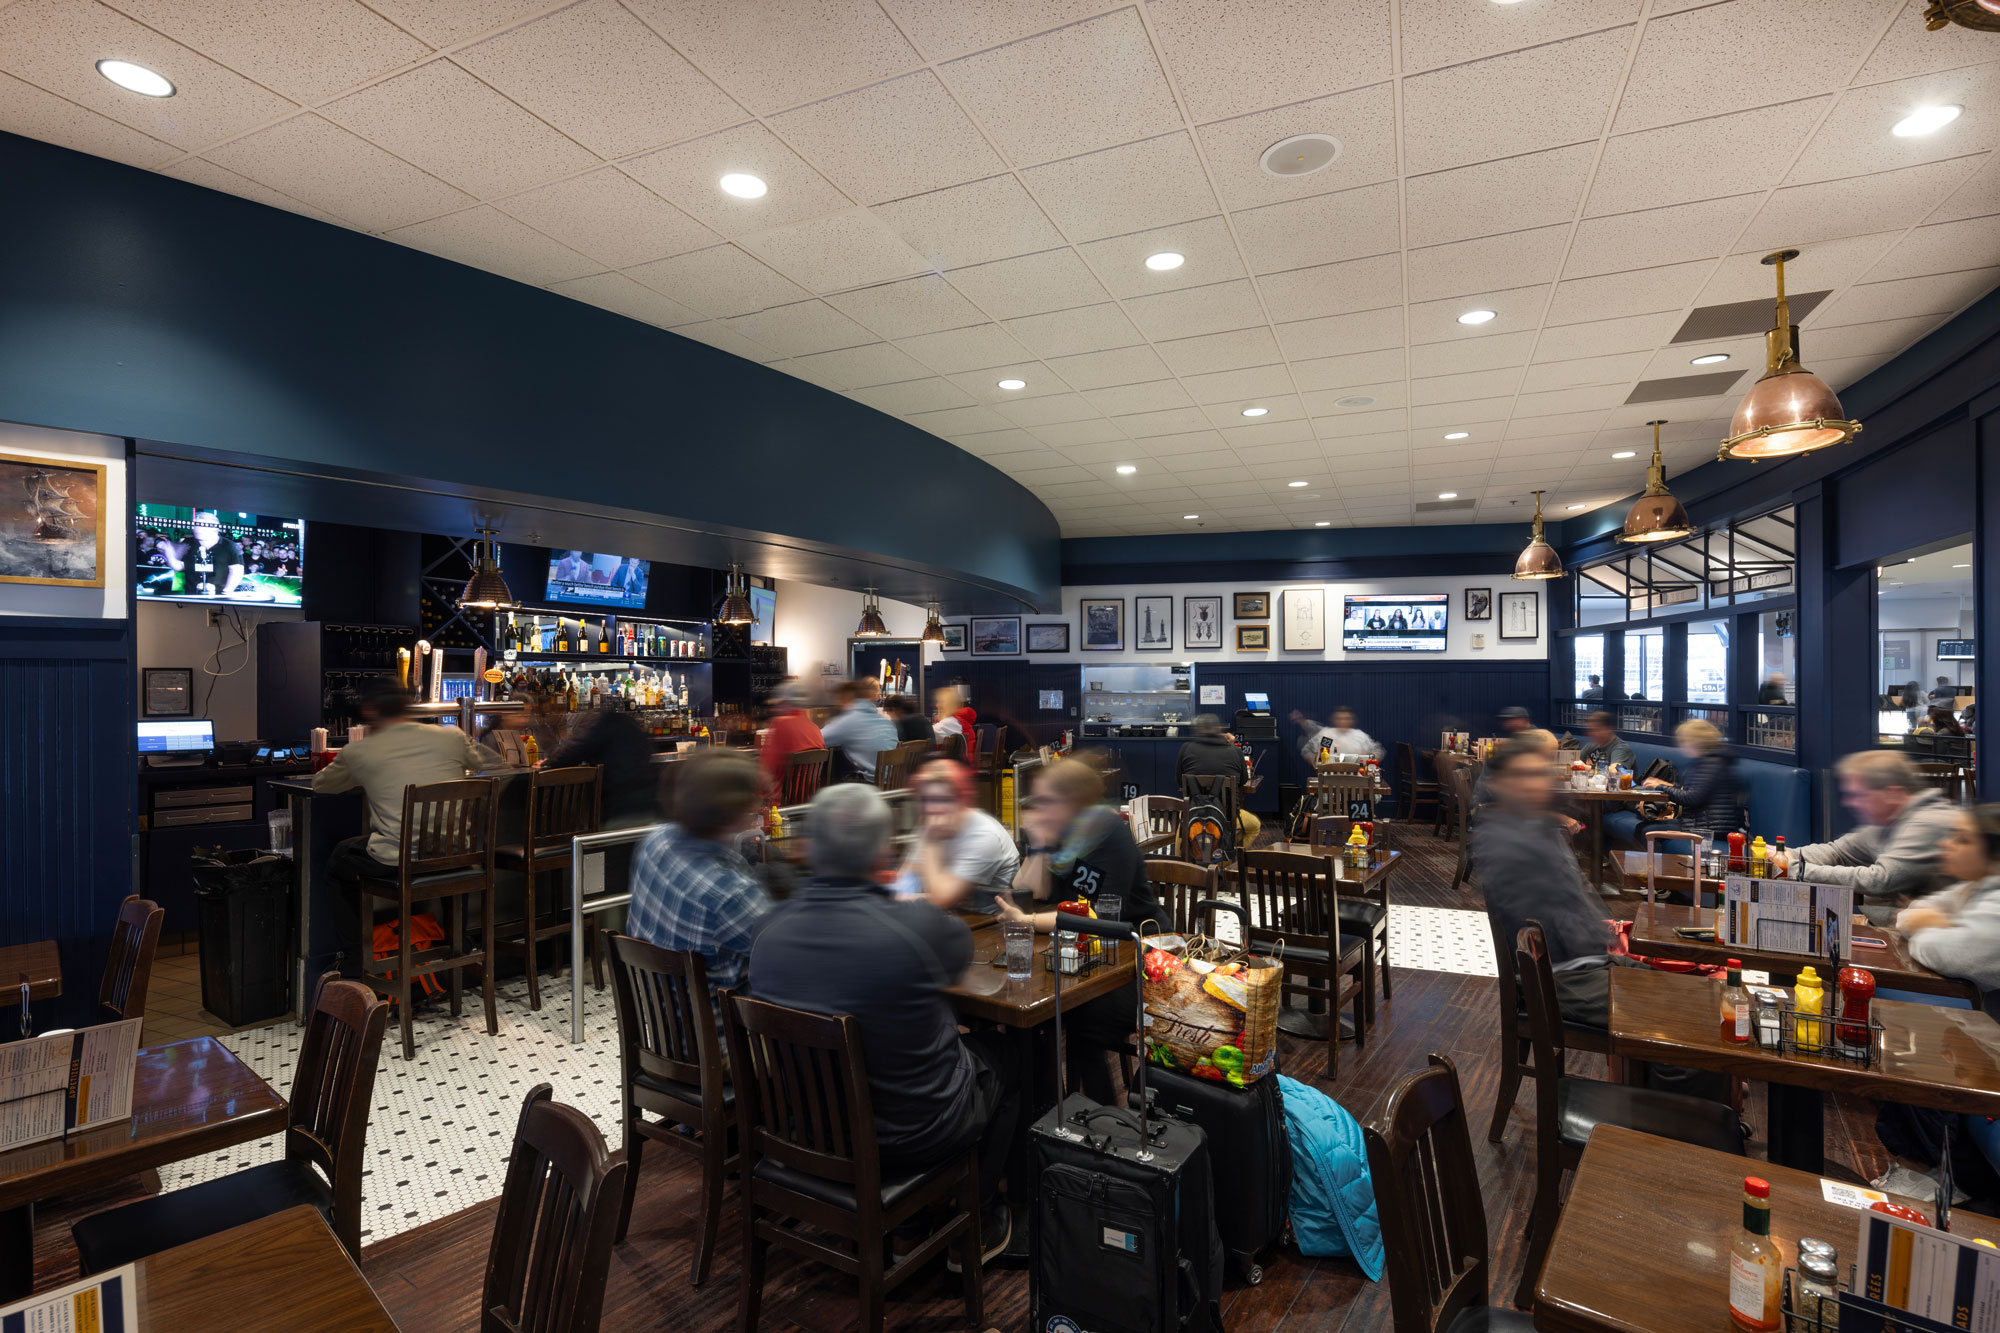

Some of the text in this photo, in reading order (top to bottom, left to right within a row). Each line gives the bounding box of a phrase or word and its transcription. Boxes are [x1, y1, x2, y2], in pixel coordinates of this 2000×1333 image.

[1242, 745, 1252, 754] 20
[1321, 739, 1331, 747] 22
[1123, 784, 1137, 799] 19
[1351, 803, 1369, 818] 24
[1072, 865, 1101, 895] 25
[1161, 1011, 1212, 1045] Fresh
[69, 1059, 80, 1099] APPETIZERS
[1867, 1273, 1882, 1300] RÉES
[1955, 1305, 1969, 1329] ADS
